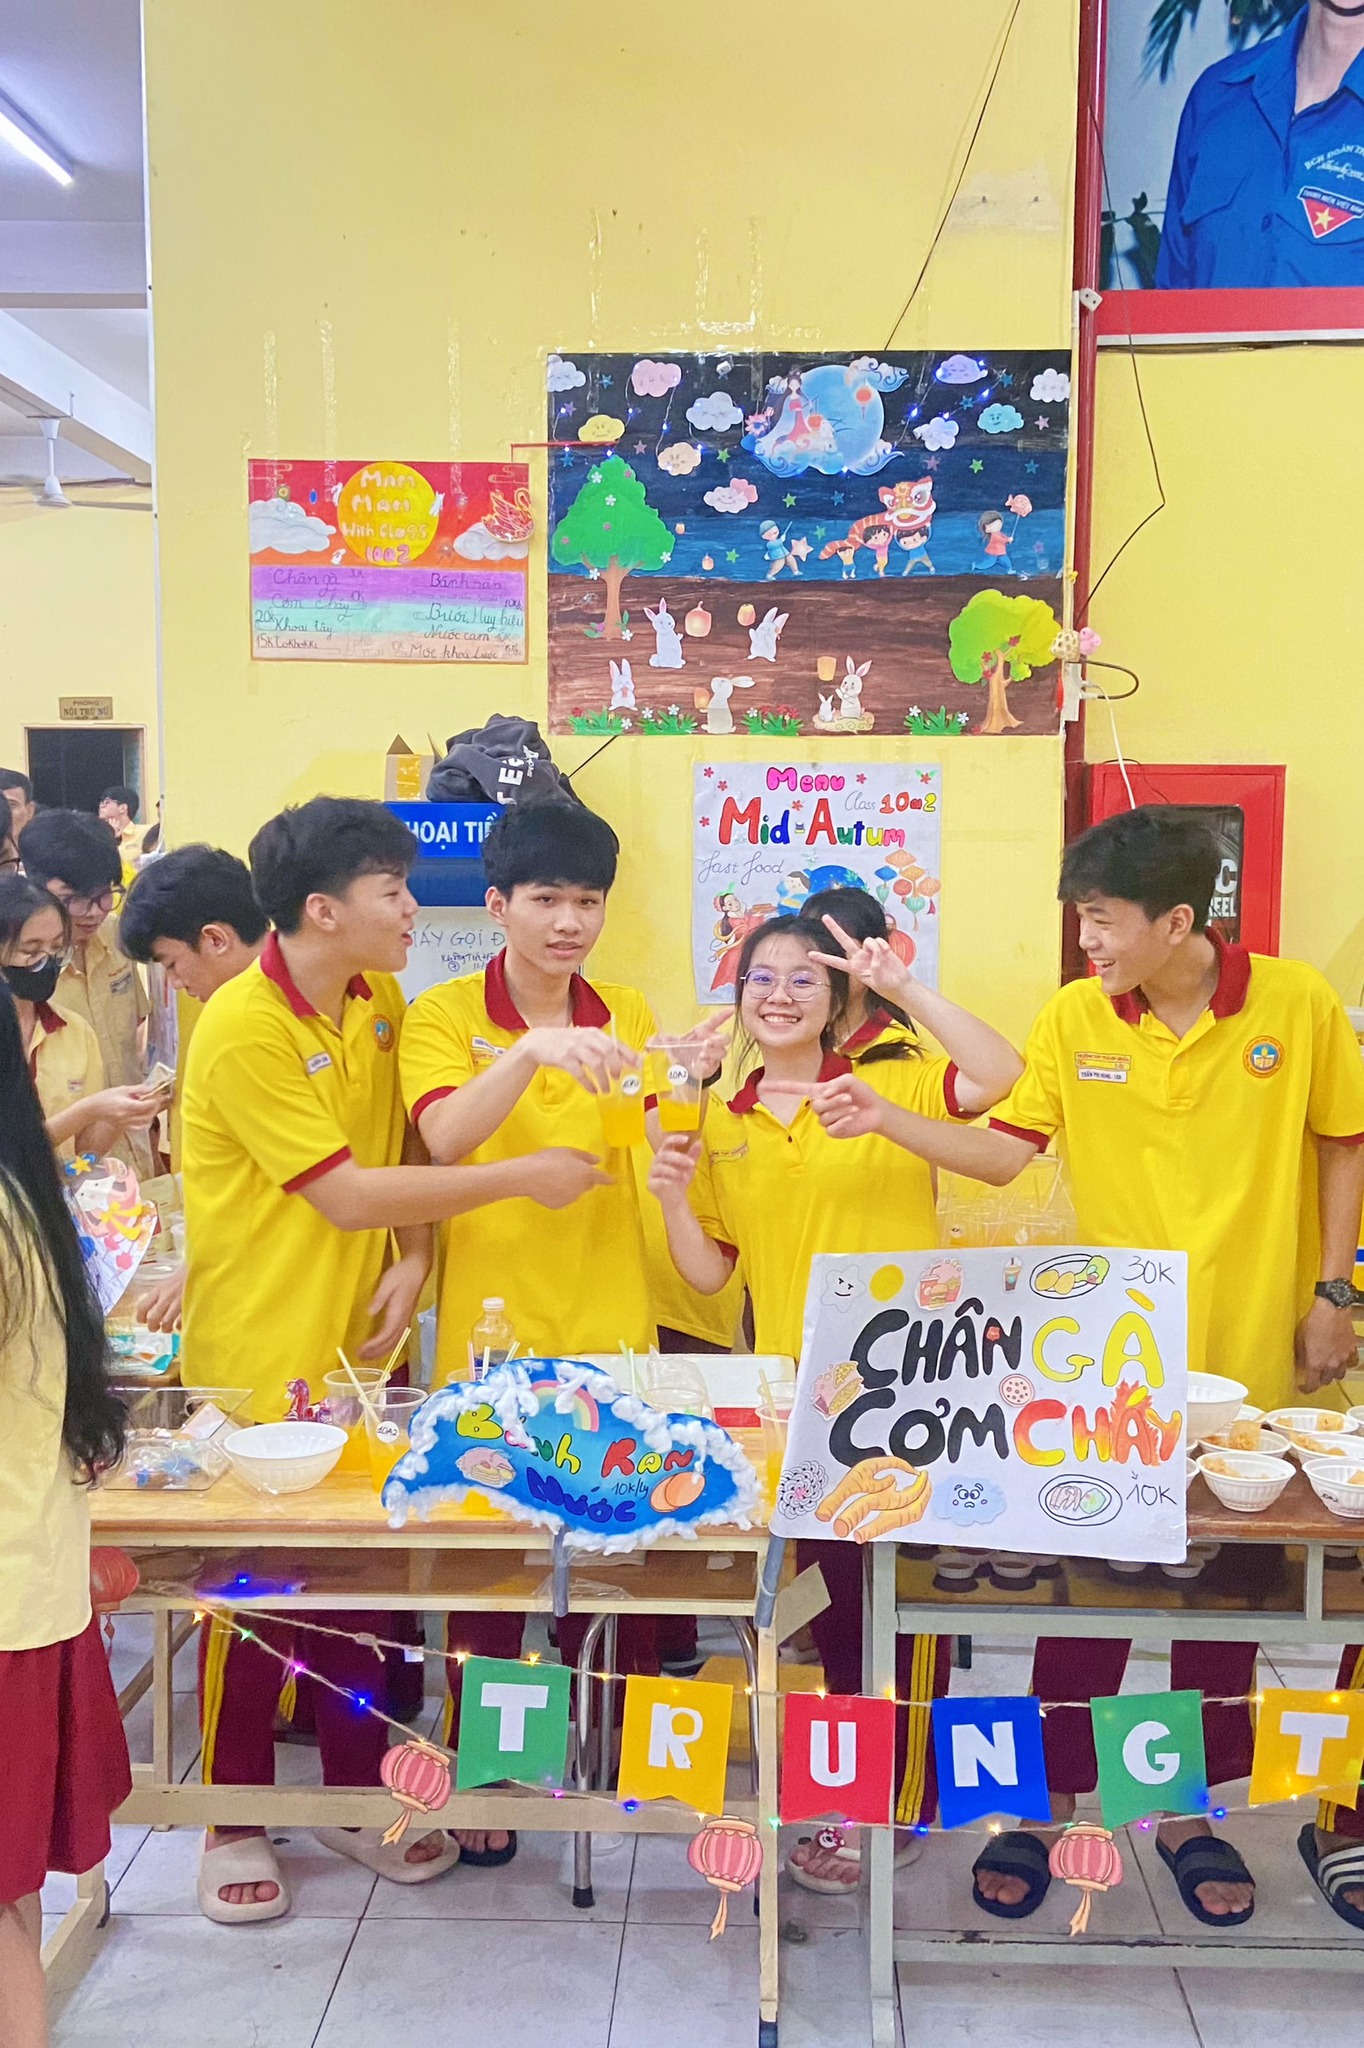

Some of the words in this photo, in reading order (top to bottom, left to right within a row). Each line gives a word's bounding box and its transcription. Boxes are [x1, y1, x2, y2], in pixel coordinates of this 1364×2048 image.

[1304, 154, 1325, 170] BCH
[273, 568, 319, 585] Chân
[319, 572, 341, 598] gà
[430, 572, 470, 589] Bánh
[271, 593, 303, 609] Cơm
[315, 619, 333, 640] tây
[464, 633, 490, 641] cam
[767, 767, 845, 792] Menu
[844, 790, 876, 811] Class
[1124, 1255, 1176, 1285] 30K
[850, 1297, 1023, 1389] CHÂN
[1032, 1288, 1166, 1388] GÀ
[377, 1427, 398, 1437] 10A2
[829, 1387, 1010, 1468] CƠM
[1013, 1385, 1183, 1468] CHÁY
[601, 1437, 695, 1478] Ran
[1126, 1480, 1178, 1507] 10K
